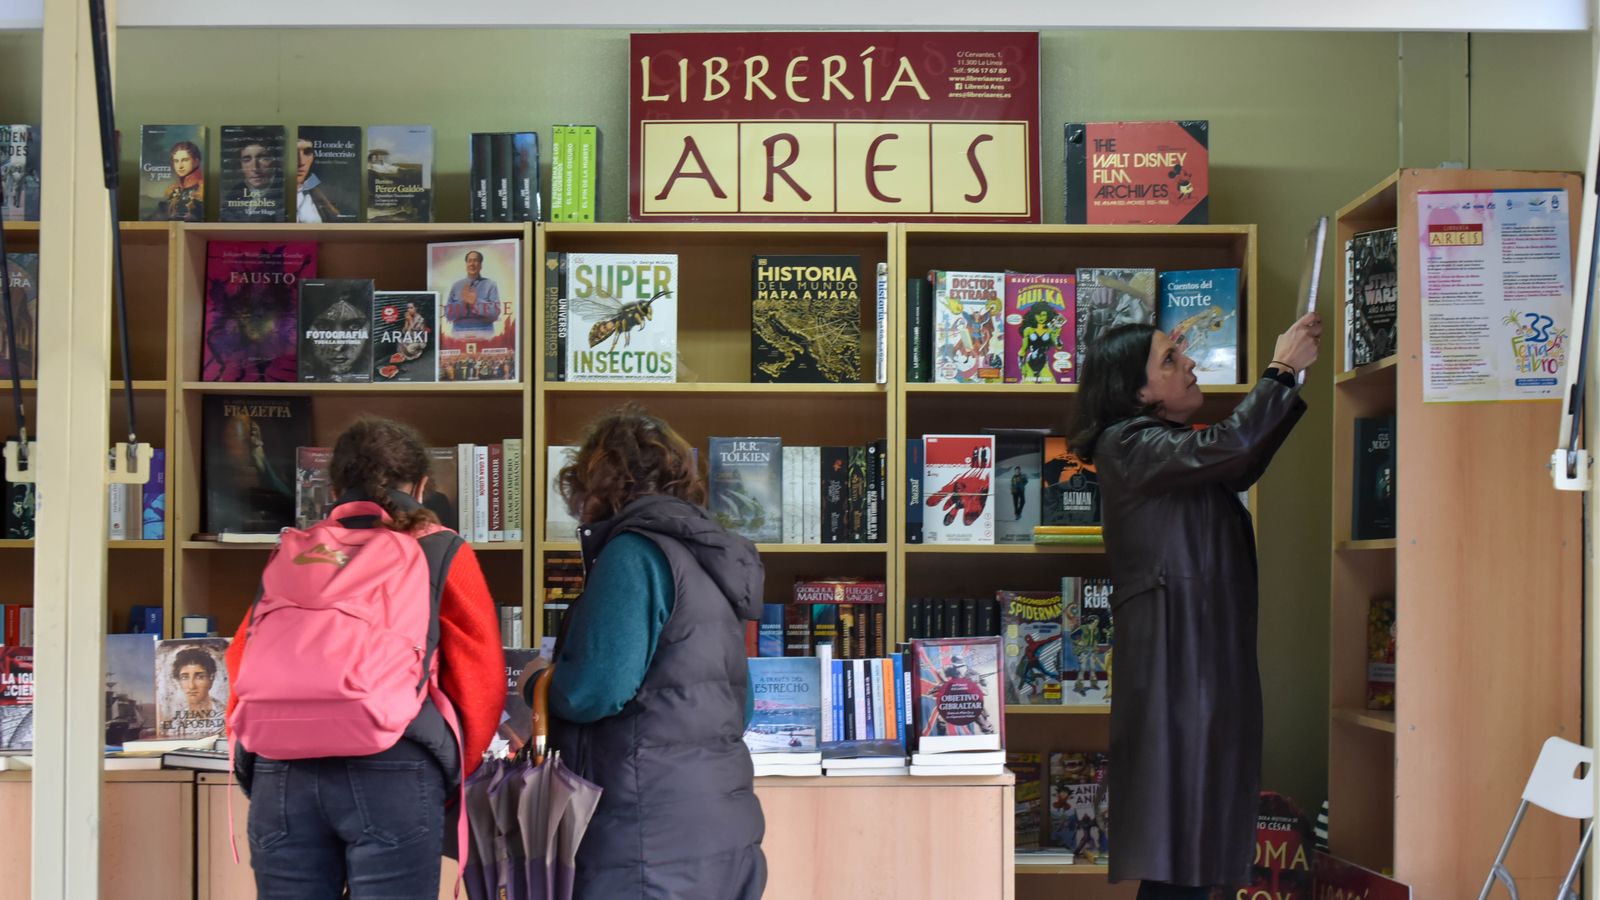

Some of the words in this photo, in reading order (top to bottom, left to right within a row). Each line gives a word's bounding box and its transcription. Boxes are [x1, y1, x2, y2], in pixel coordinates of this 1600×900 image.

[640, 46, 930, 103] LIBRERÍA
[313, 140, 322, 148] El
[322, 140, 343, 149] conde
[344, 140, 354, 149] de
[1093, 138, 1116, 152] THE
[313, 149, 356, 158] Montecristo
[1093, 153, 1130, 168] WALT
[1134, 152, 1187, 168] DISNEY
[143, 163, 171, 172] Guerra
[654, 133, 994, 203] ARES
[1093, 169, 1132, 184] FILM
[243, 188, 261, 198] Los
[374, 184, 396, 193] Pérez
[397, 183, 425, 193] Galdós
[1094, 184, 1168, 199] ARCHIVES
[228, 197, 275, 207] miserables
[1431, 232, 1479, 244] ARES
[230, 271, 296, 285] FAUSTO
[758, 266, 857, 282] HISTORIA
[575, 264, 672, 299] SUPER
[758, 281, 786, 291] DEL
[798, 281, 858, 291] MUNDO
[952, 278, 995, 289] DOCTOR
[1167, 281, 1199, 291] Cuentos
[1200, 280, 1213, 289] del
[758, 290, 798, 299] MAPA
[803, 290, 812, 299] A
[817, 290, 858, 299] MAPA
[950, 289, 998, 300] EXTRAÑO
[1016, 286, 1066, 310] HULKA
[1167, 292, 1212, 308] Norte
[1364, 287, 1397, 306] WARS
[550, 287, 558, 357] DINOSAURIOS
[558, 298, 567, 338] UNIVERSO
[1524, 312, 1554, 343] 33
[305, 330, 369, 339] FOTOGRAFÍA
[380, 330, 428, 343] ARAKI
[573, 350, 672, 374] INSECTOS
[223, 405, 292, 418] FRAZETTA
[732, 442, 760, 453] J.R.R.
[720, 452, 770, 463] TOLKIEN
[492, 458, 500, 489] MORIR
[492, 488, 500, 496] O
[1063, 491, 1092, 505] BATMAN
[492, 496, 500, 530] VENCER
[507, 515, 513, 523] EL
[845, 587, 872, 595] FUEGO
[1084, 597, 1110, 608] KUB
[1, 673, 15, 684] LA
[754, 682, 809, 694] ESTRECHO
[941, 694, 980, 703] OBJETIVO
[939, 702, 982, 711] GIBRALTAR
[174, 710, 216, 719] JULIANO
[163, 721, 177, 730] EL
